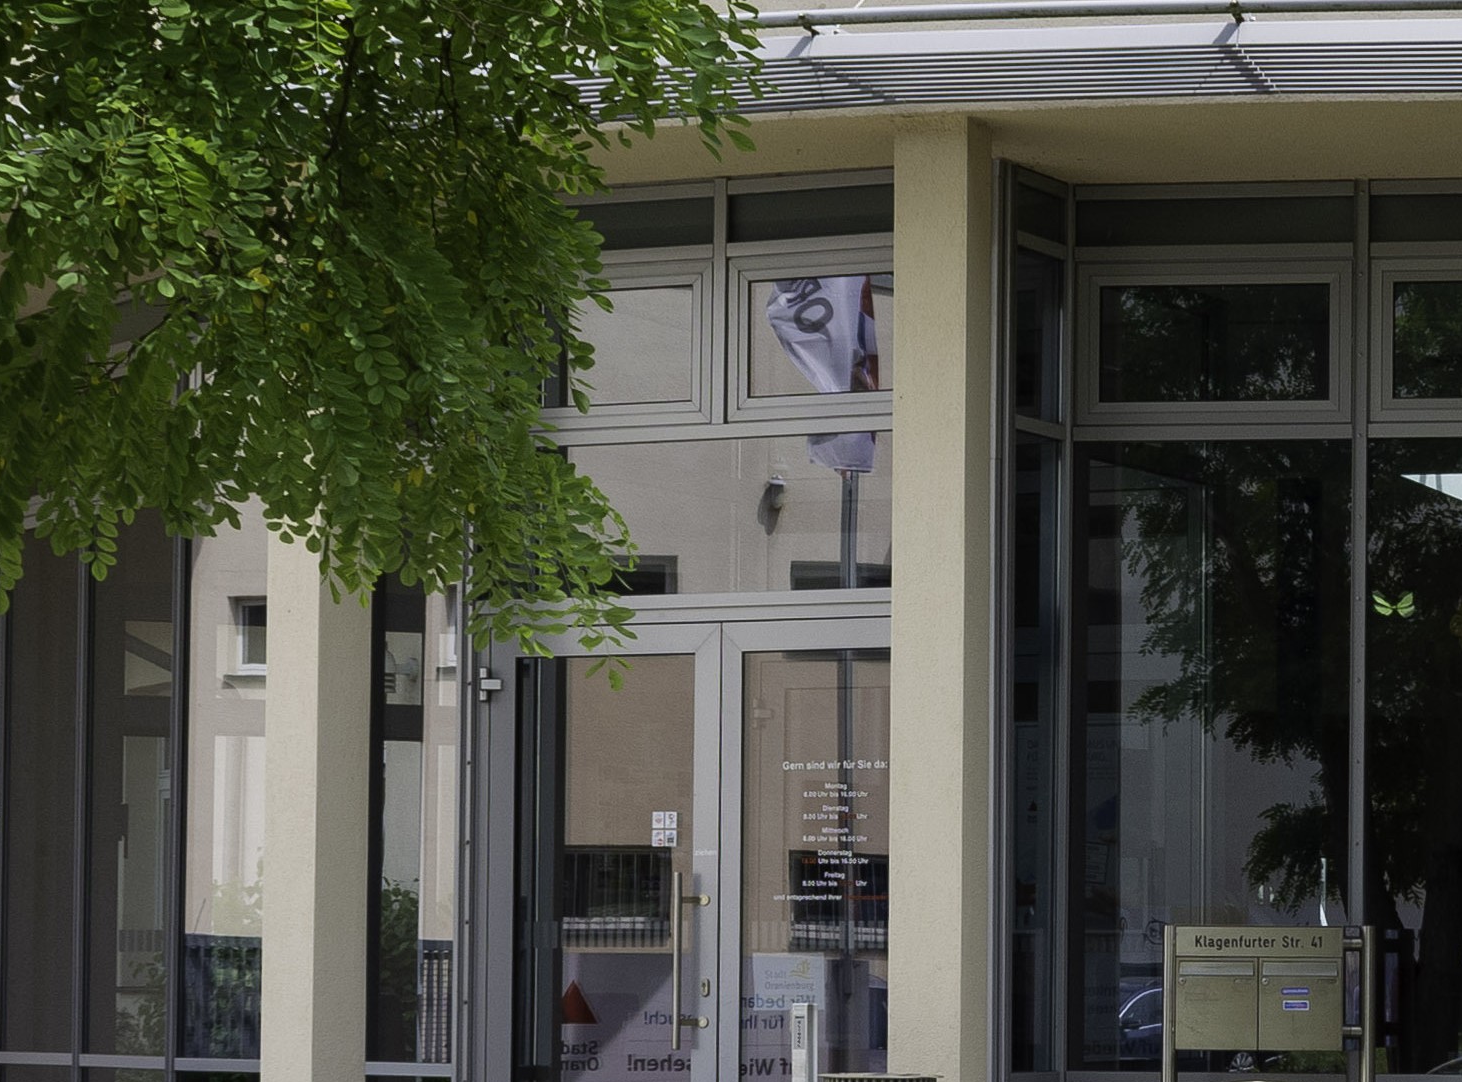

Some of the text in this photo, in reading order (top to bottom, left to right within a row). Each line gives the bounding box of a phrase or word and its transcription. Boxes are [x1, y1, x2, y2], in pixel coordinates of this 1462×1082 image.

[782, 760, 888, 771] Gern sind wir für Sie da:
[824, 782, 847, 791] Montag
[822, 804, 849, 813] Dienstag
[817, 849, 852, 858] Donnerstag
[824, 871, 845, 880] Freitag
[1194, 935, 1323, 951] Klagenfurter Str. 41
